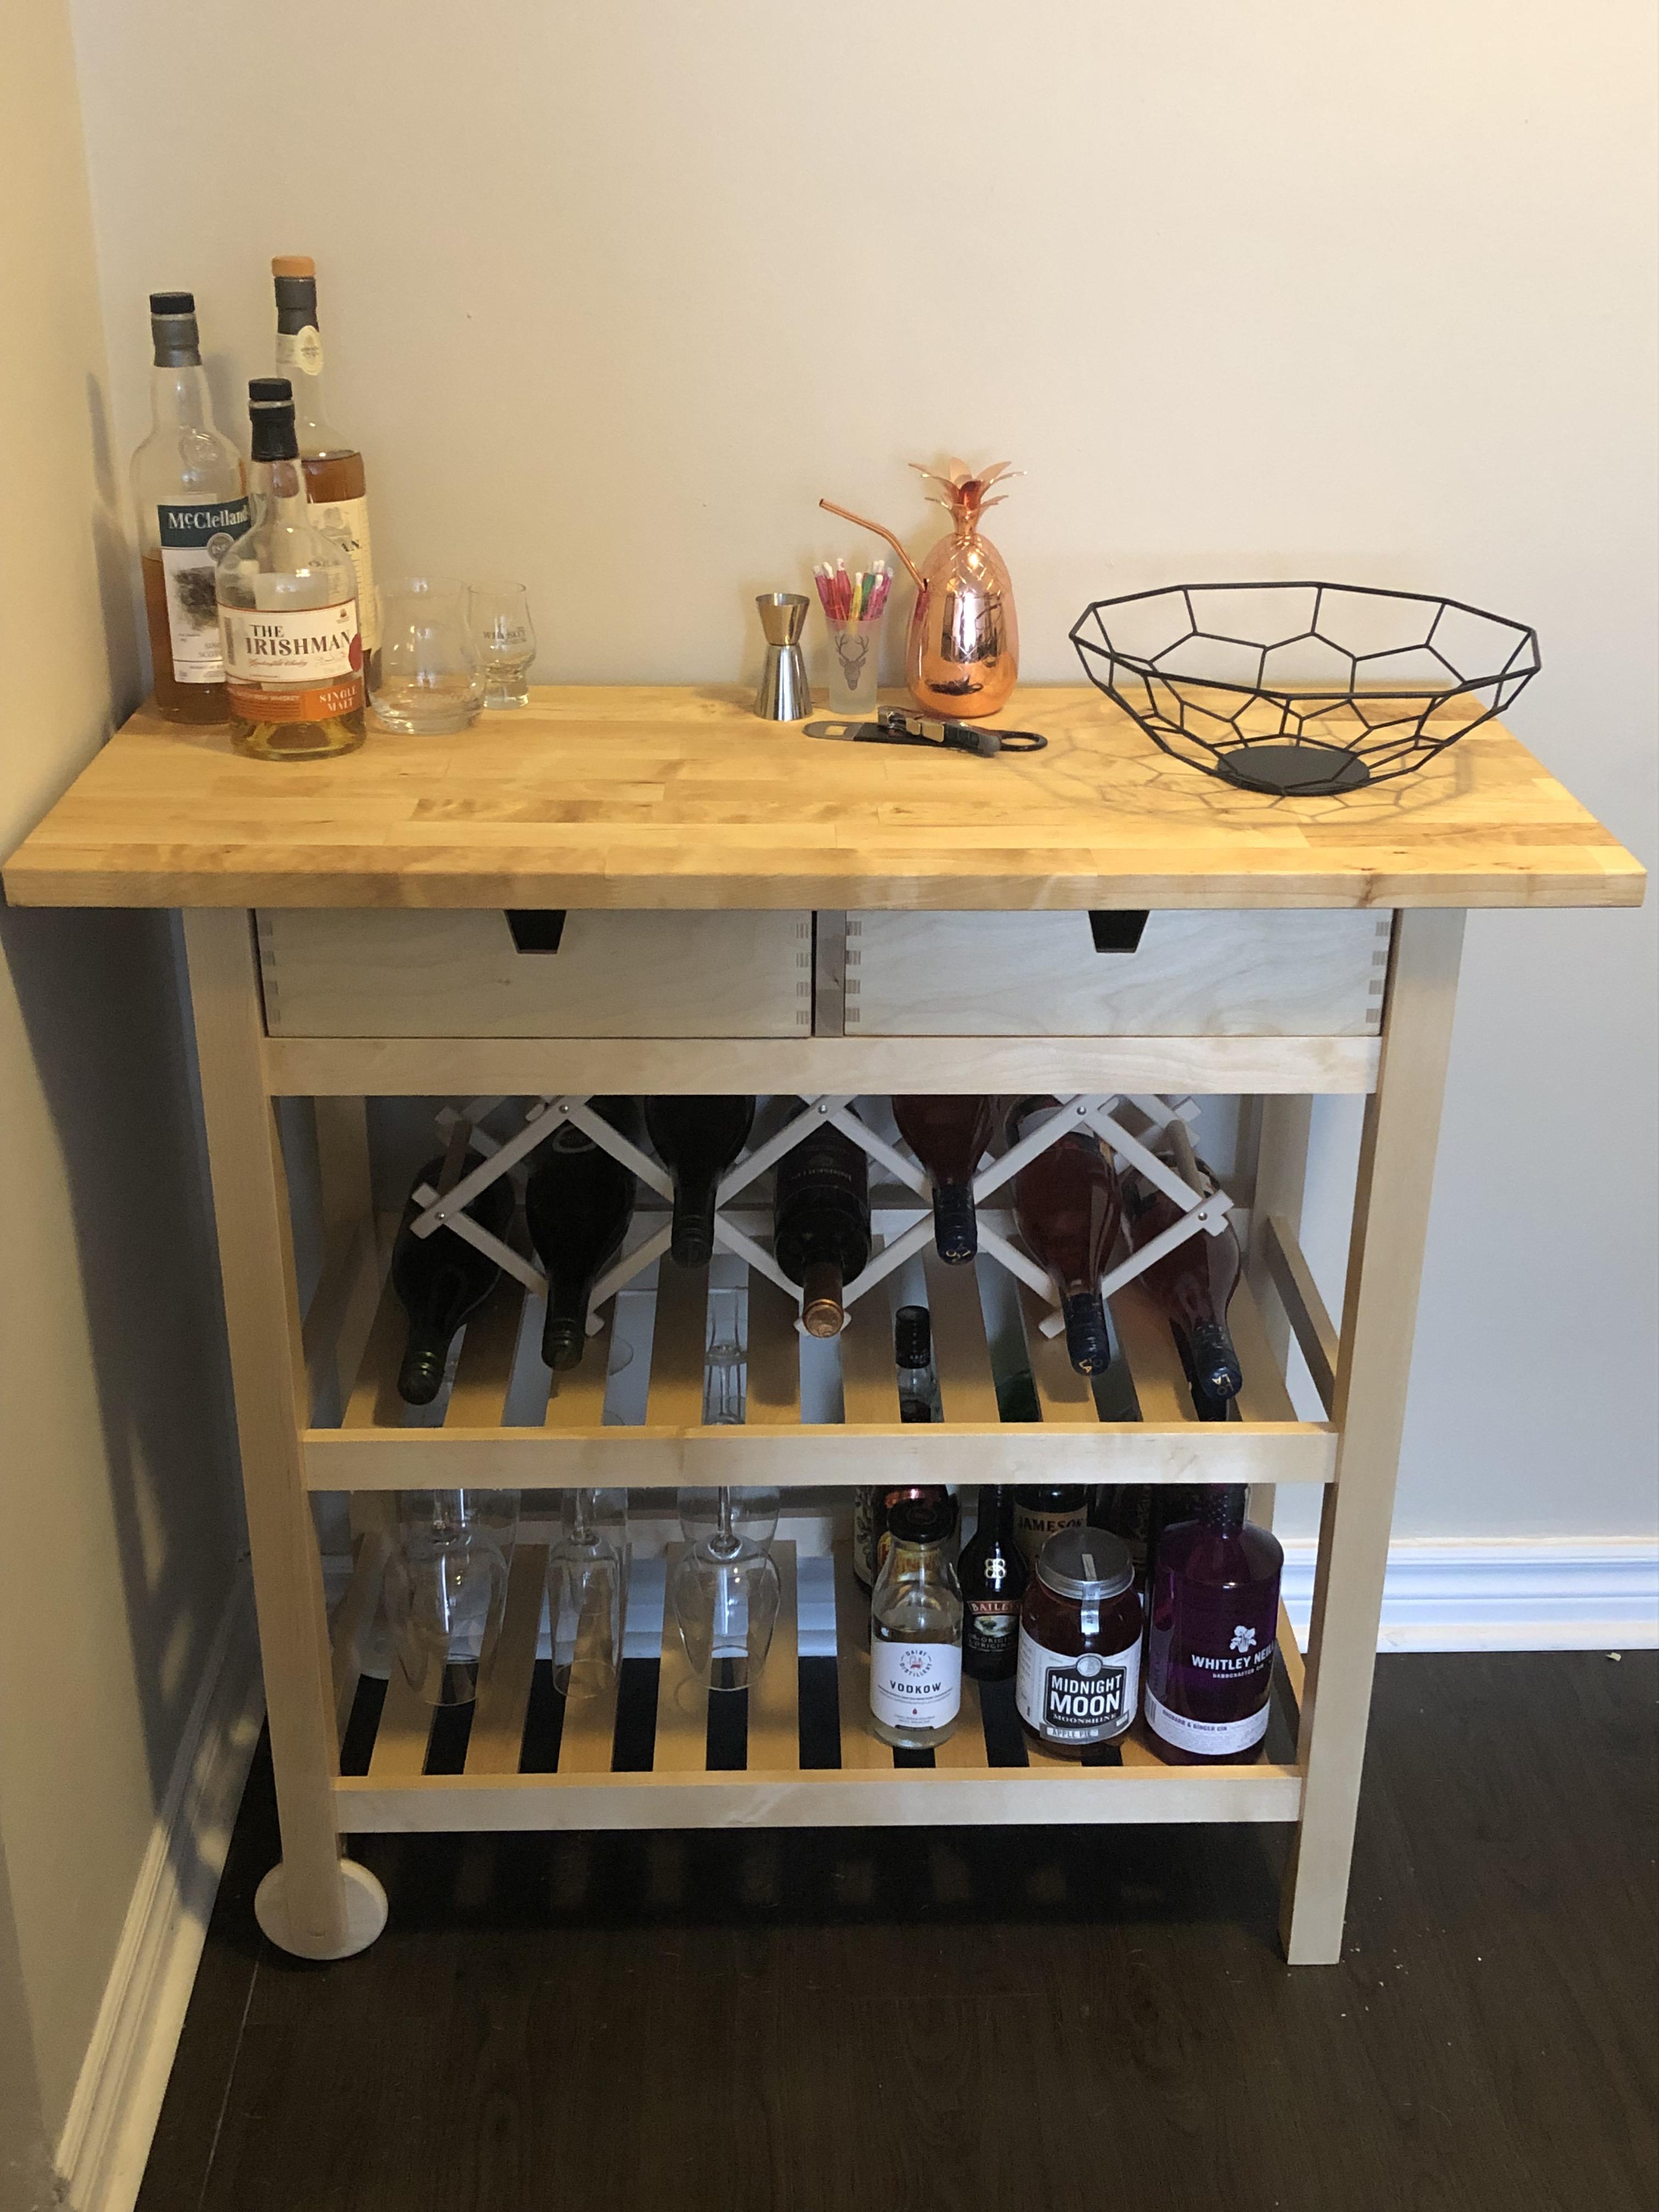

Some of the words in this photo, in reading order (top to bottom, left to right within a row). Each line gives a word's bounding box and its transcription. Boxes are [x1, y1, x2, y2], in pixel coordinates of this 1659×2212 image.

[250, 624, 285, 638] THE
[245, 631, 351, 656] IRISHMAN
[319, 685, 357, 702] SINGLE
[326, 698, 354, 712] MALT
[1191, 1654, 1251, 1671] WHITLEY
[889, 1679, 942, 1694] VODKOW
[1052, 1674, 1122, 1695] MIDNIGHT
[1050, 1690, 1120, 1717] MOON
[1053, 1713, 1117, 1724] MOONSHINE
[1052, 1729, 1076, 1739] APPLE
